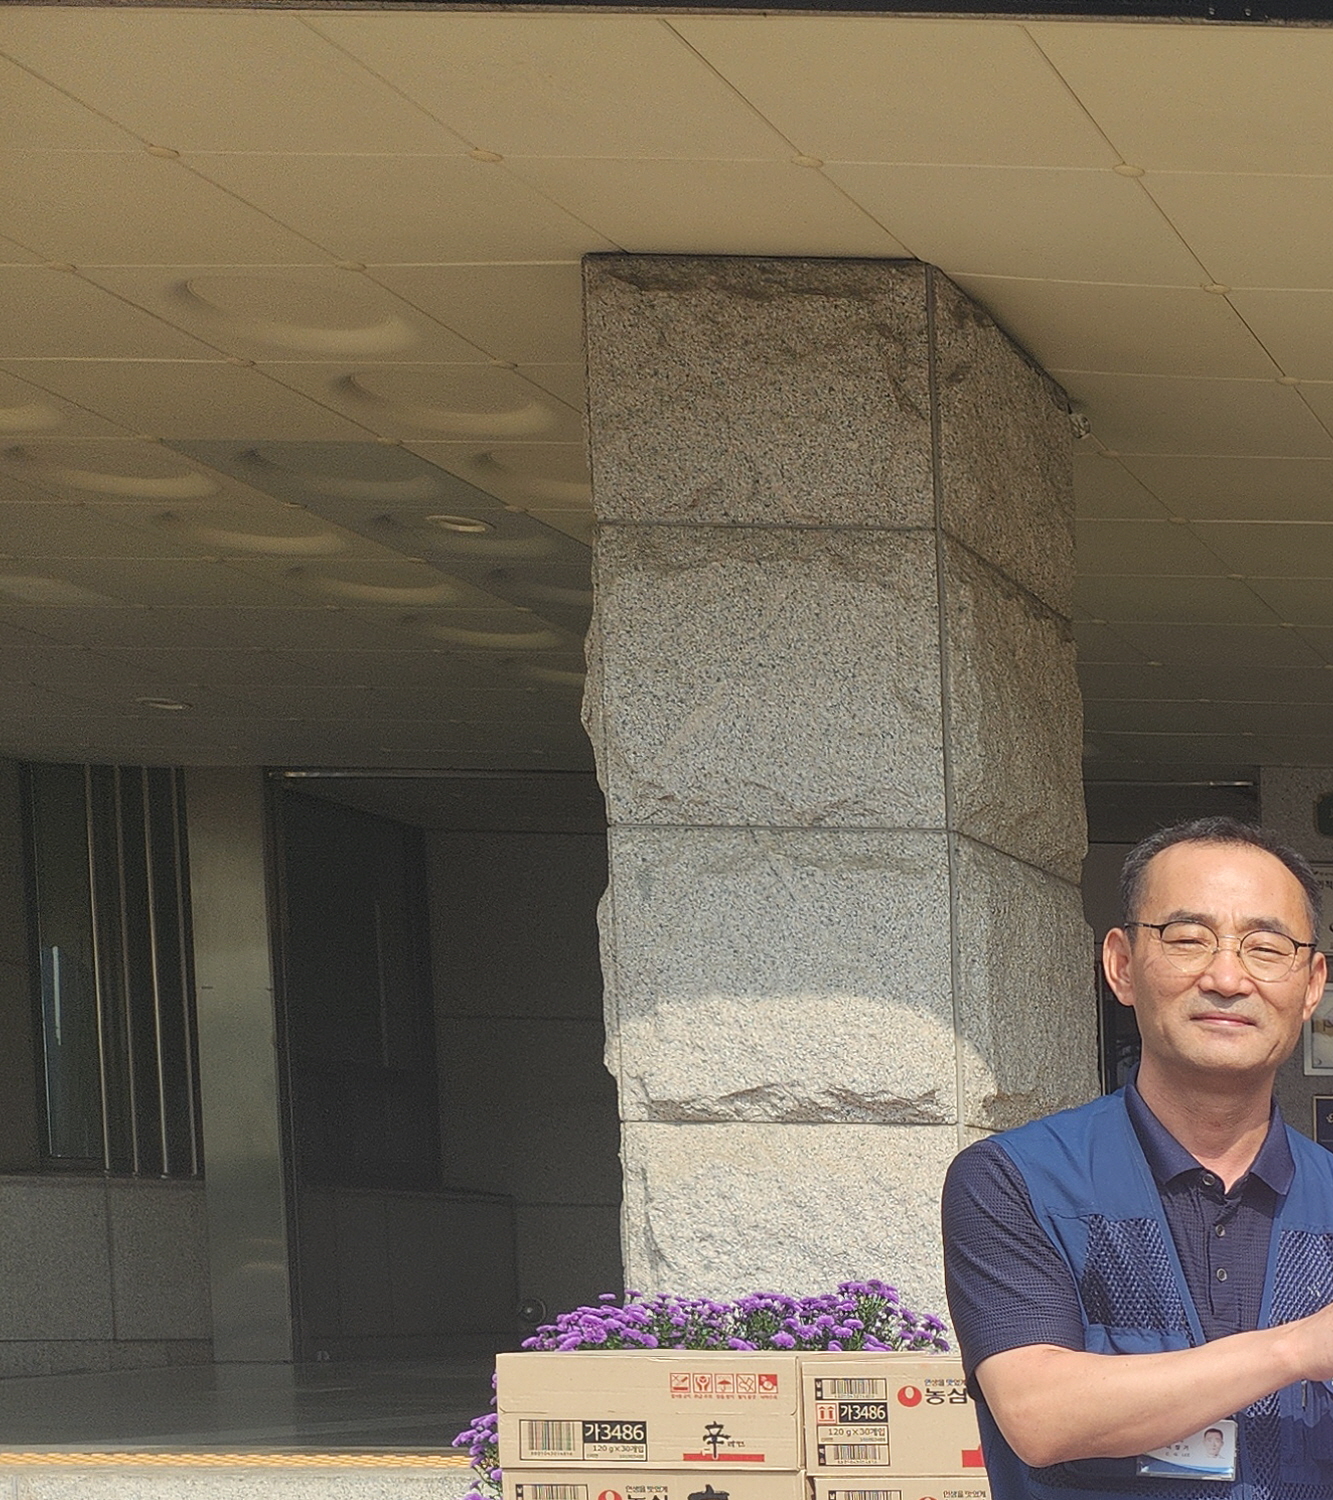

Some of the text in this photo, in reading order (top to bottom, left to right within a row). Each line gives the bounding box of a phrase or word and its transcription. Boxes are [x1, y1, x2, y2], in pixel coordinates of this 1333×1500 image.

[925, 1388, 968, 1405] 농심
[841, 1406, 886, 1420] 가3486
[585, 1423, 644, 1442] 가3486
[703, 1421, 730, 1458] 辛
[828, 1428, 844, 1436] 120
